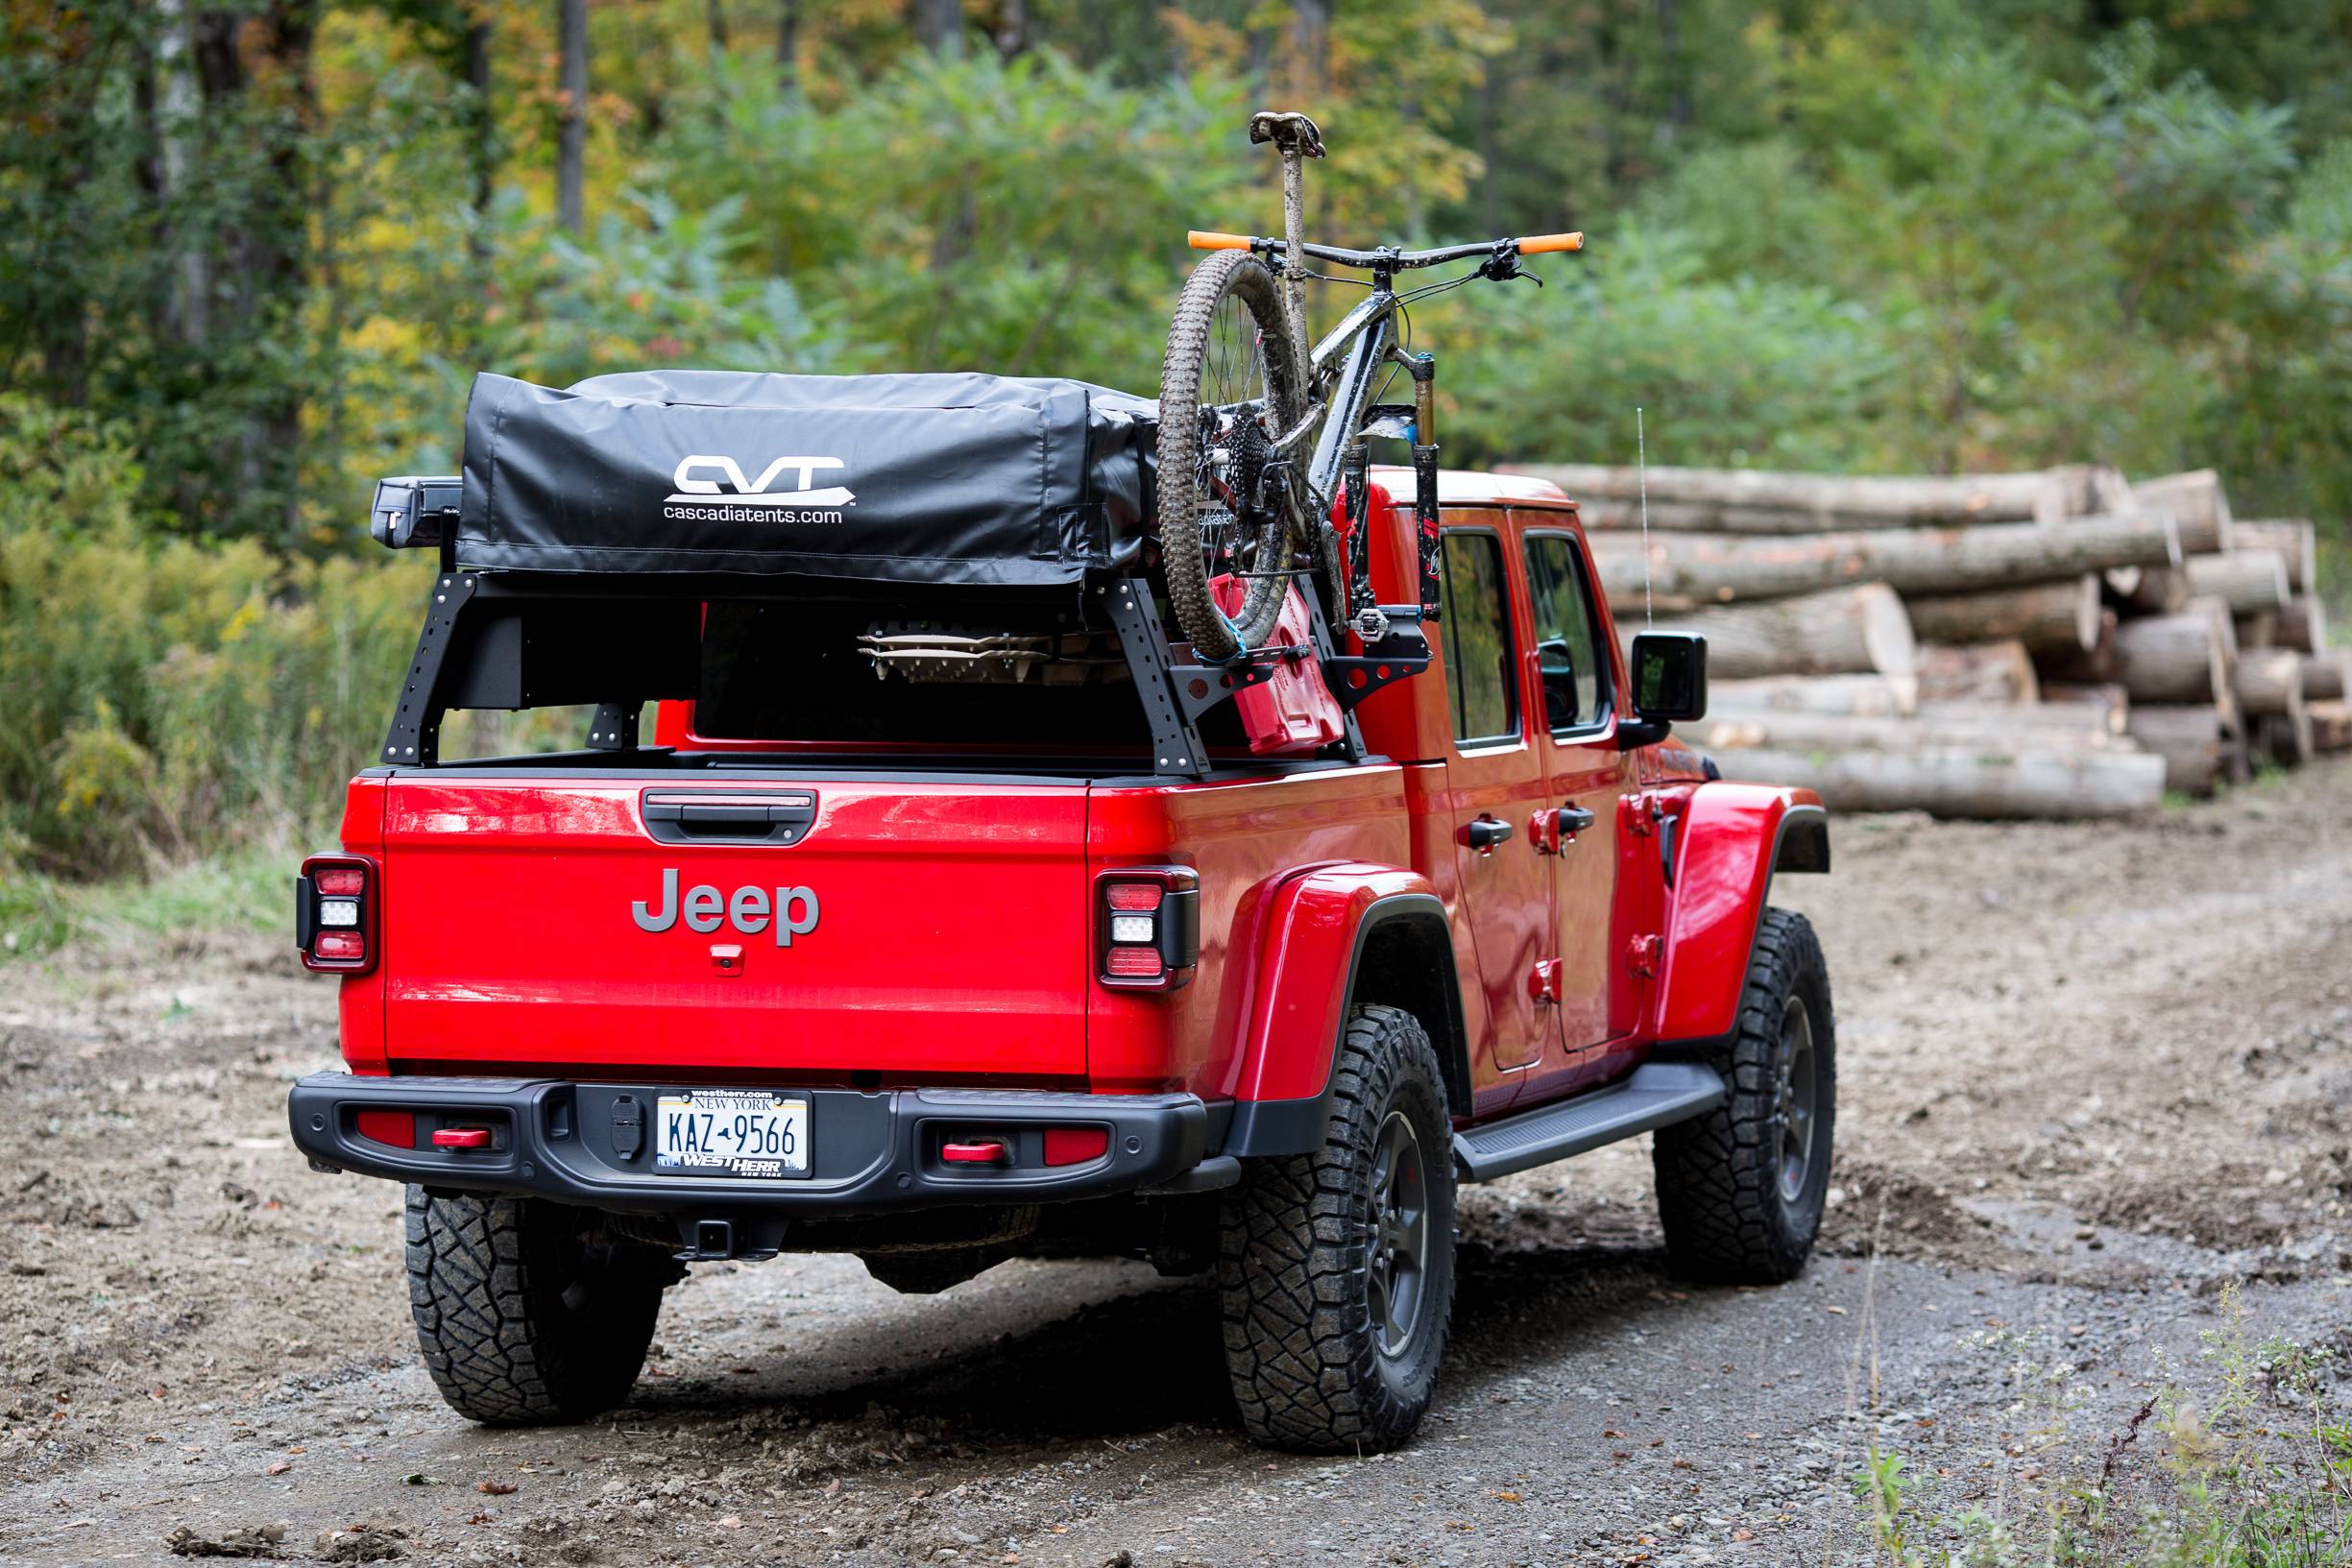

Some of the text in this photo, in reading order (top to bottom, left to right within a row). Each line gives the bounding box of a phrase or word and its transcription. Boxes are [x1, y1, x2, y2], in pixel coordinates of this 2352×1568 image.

[673, 455, 845, 494] CVT
[664, 505, 842, 524] cascadiatents.com
[632, 868, 820, 947] Jeep
[691, 1090, 772, 1098] westherr.com
[695, 1098, 772, 1111] NEW YORK
[669, 1113, 795, 1154] KAZ 9566
